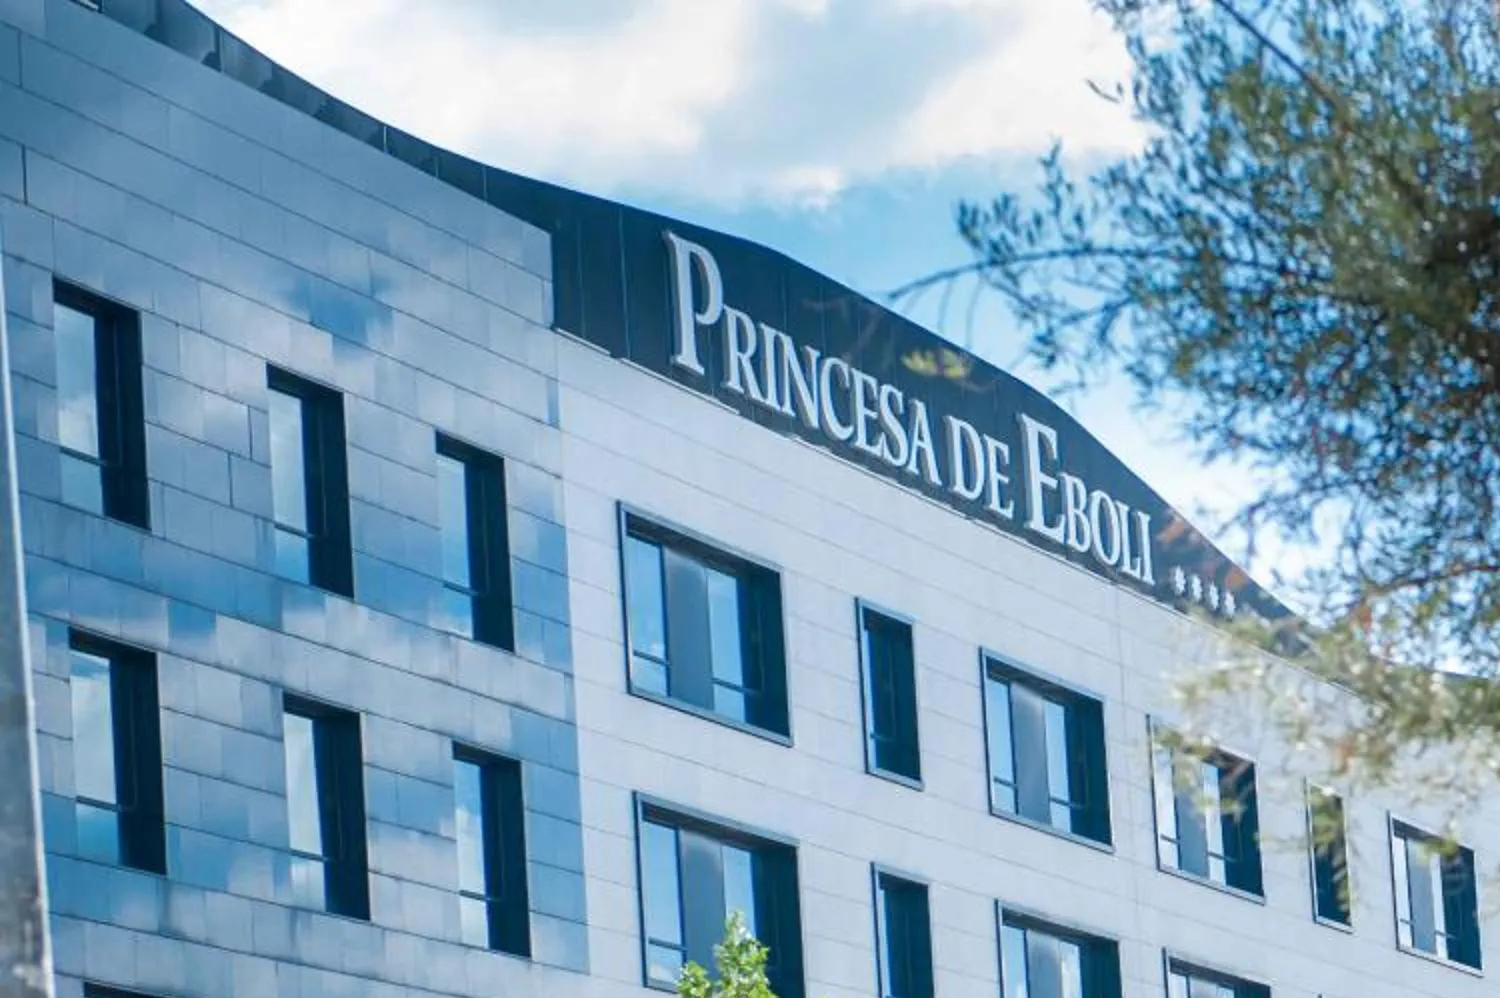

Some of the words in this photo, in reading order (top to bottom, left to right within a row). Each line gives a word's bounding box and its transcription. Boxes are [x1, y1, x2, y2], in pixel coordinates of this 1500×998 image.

[663, 229, 942, 487] PRINCESA
[944, 414, 1014, 520] DE
[1019, 413, 1155, 586] EBOLI
